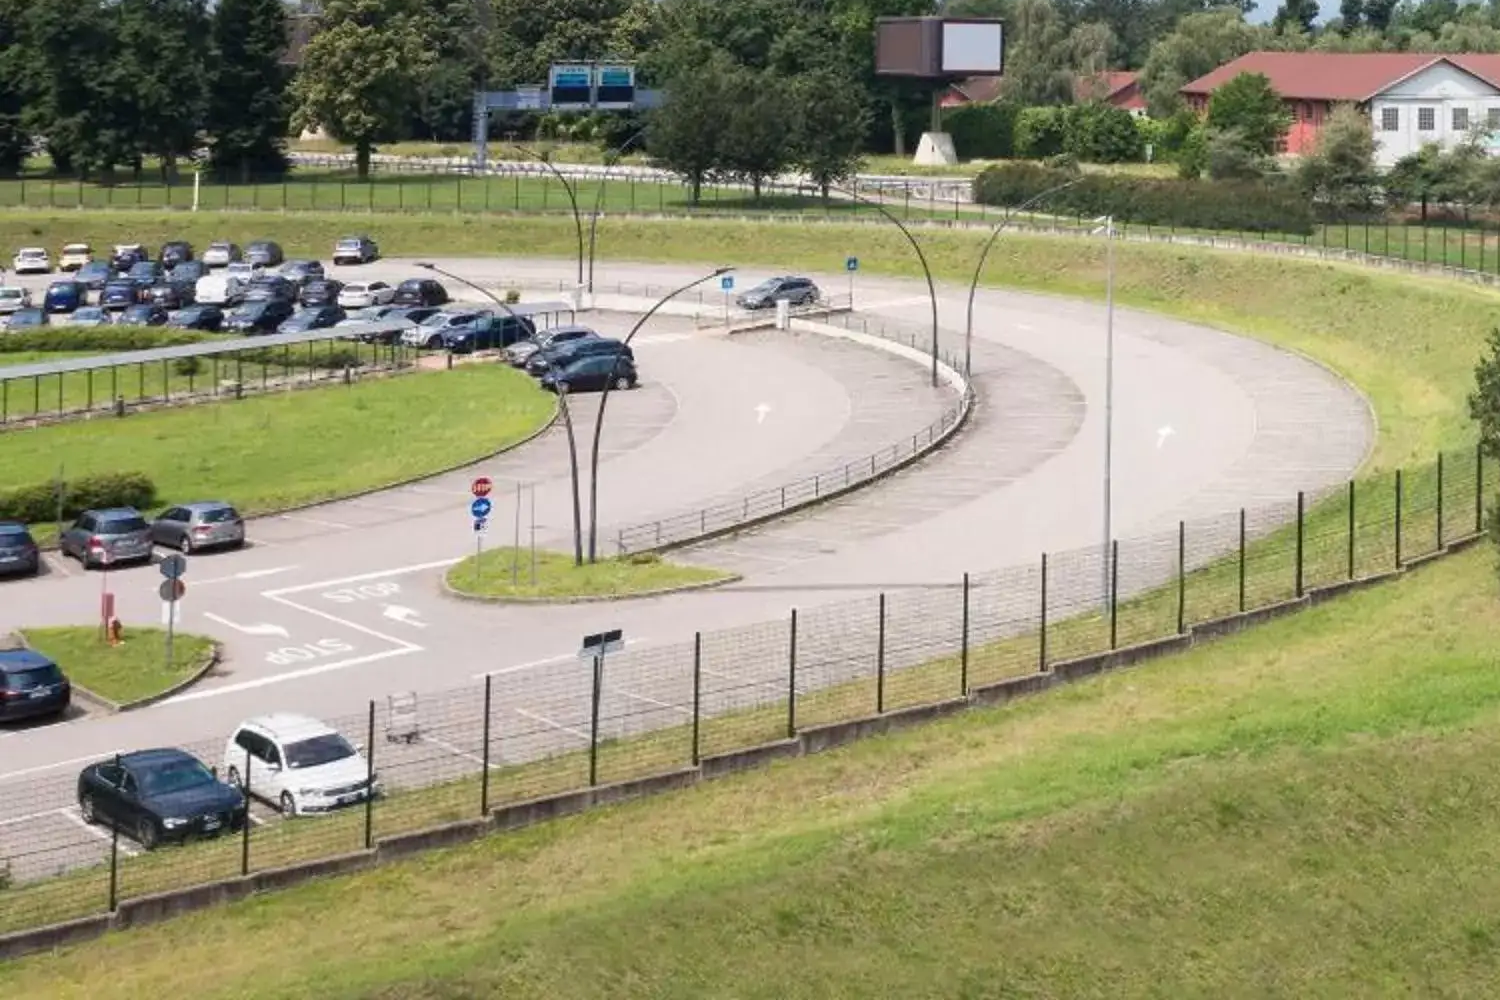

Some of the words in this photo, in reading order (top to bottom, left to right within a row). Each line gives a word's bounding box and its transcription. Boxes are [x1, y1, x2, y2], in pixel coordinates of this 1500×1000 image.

[472, 482, 493, 494] STOP
[322, 583, 400, 603] STOP
[264, 637, 352, 665] STOP
